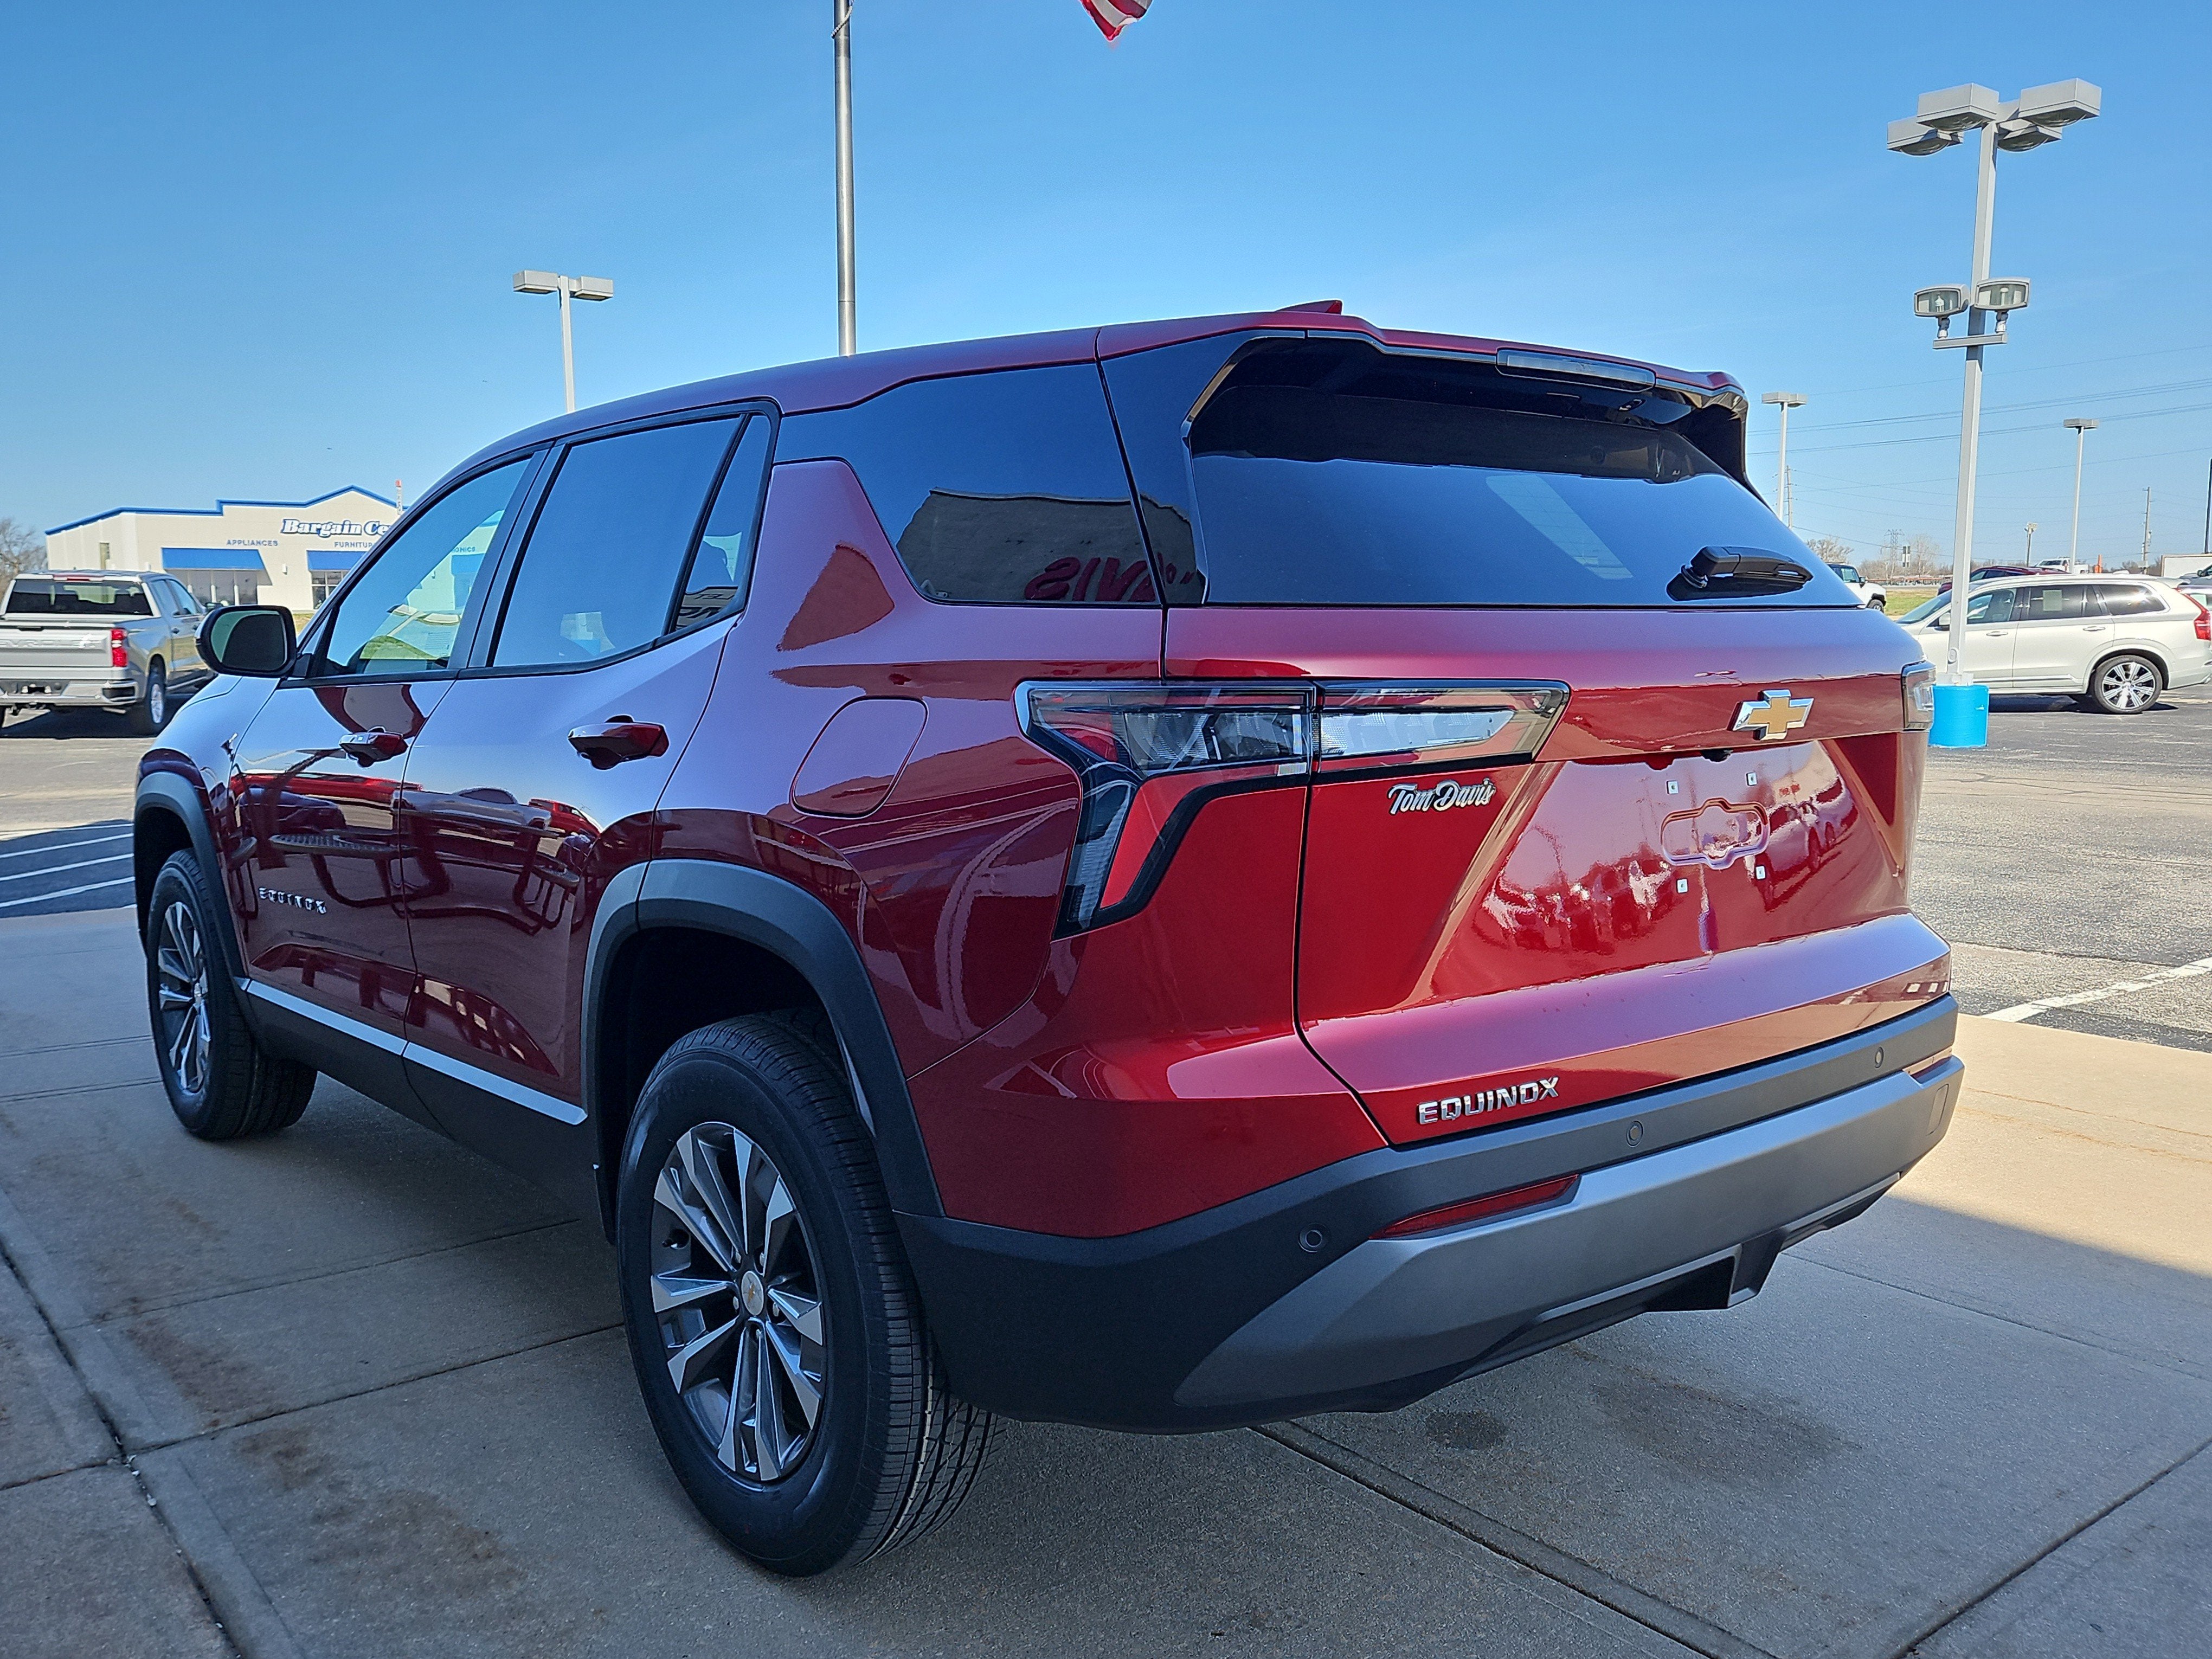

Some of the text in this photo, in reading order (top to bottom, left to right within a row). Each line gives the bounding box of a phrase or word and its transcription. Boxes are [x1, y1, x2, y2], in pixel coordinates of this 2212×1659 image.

[281, 519, 391, 538] Bargain Ce
[1387, 777, 1496, 815] Tom Davis
[1417, 1076, 1559, 1126] EQUINOX
